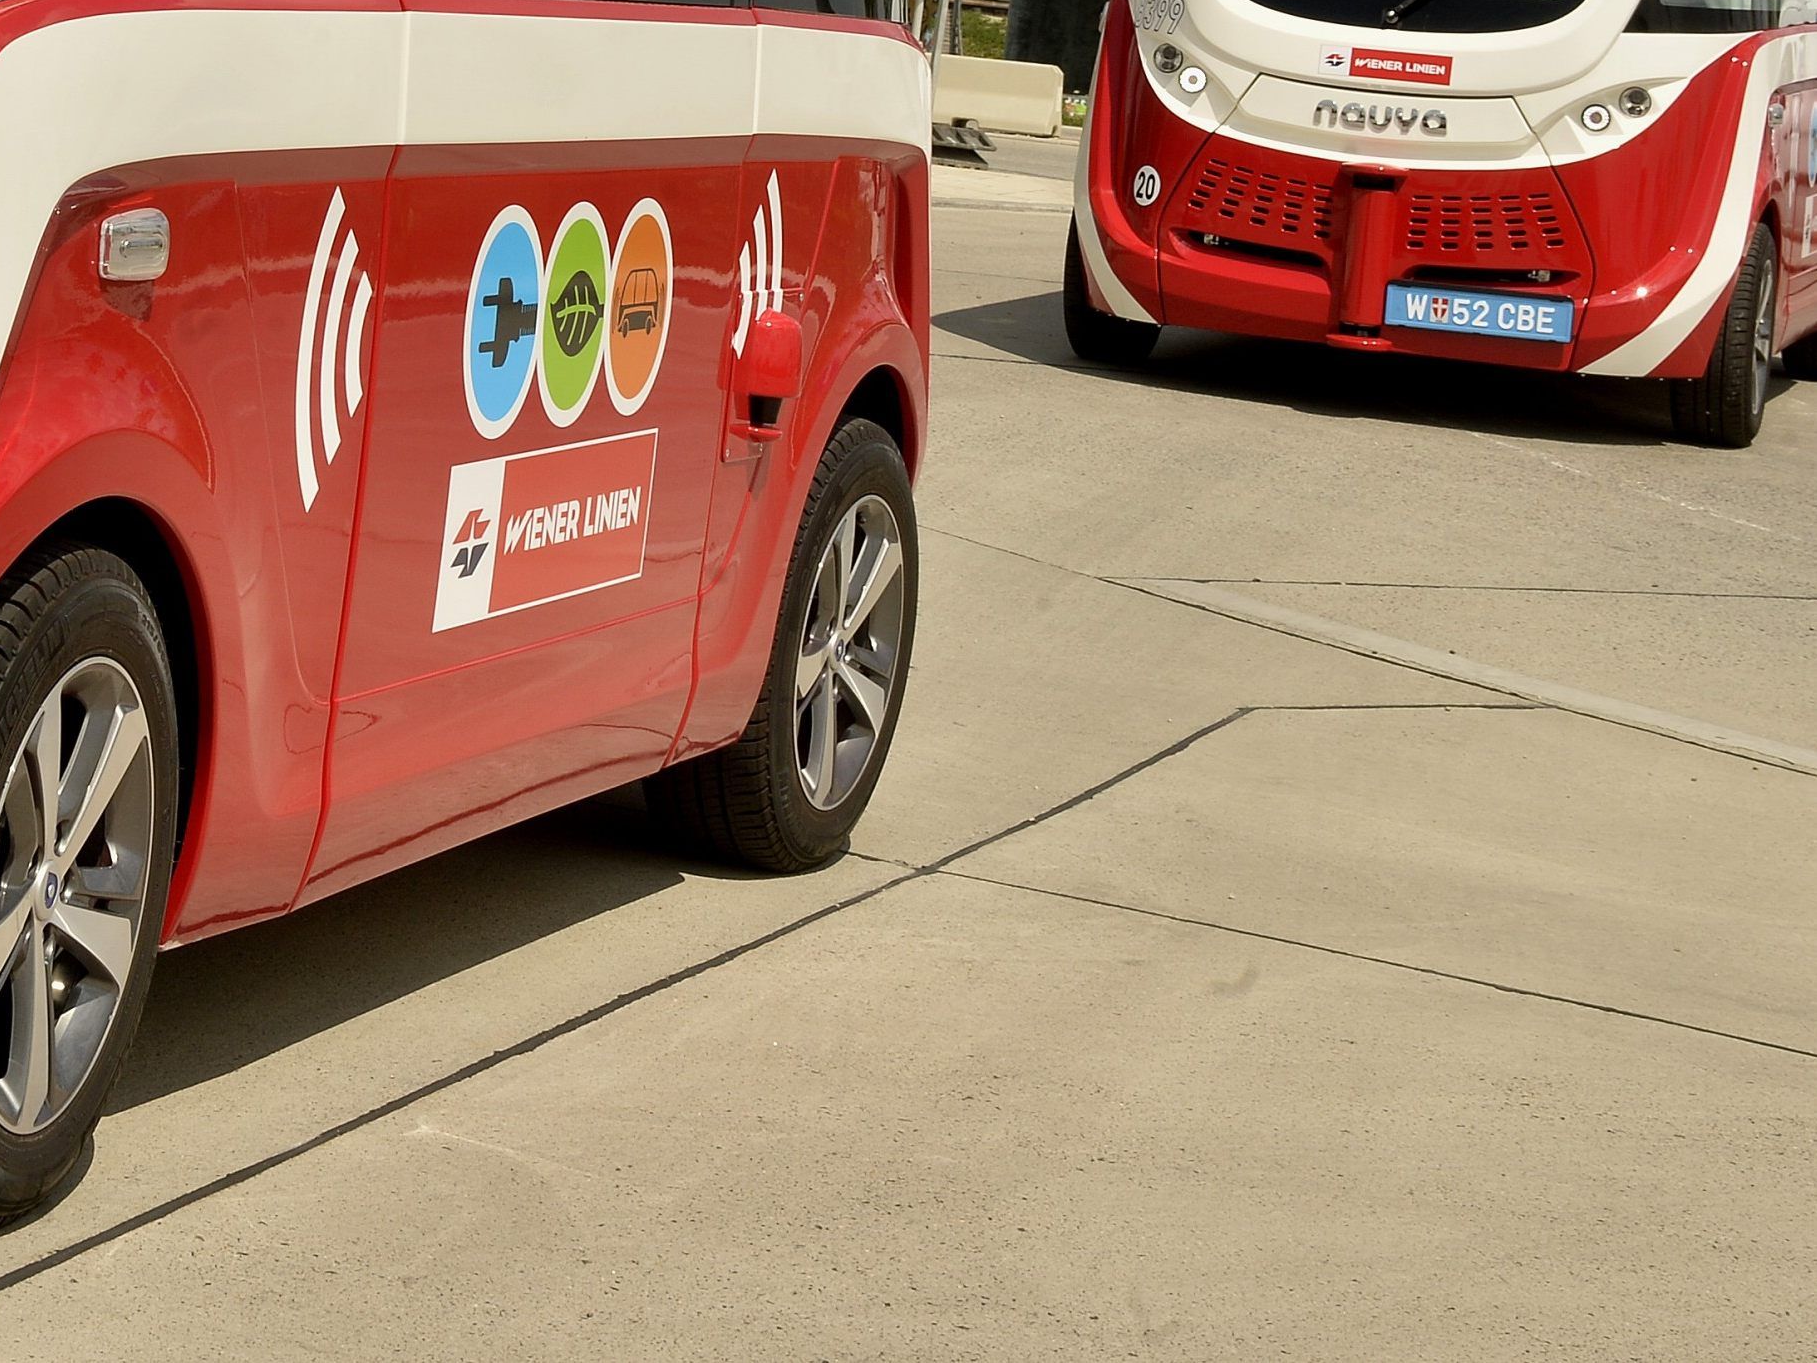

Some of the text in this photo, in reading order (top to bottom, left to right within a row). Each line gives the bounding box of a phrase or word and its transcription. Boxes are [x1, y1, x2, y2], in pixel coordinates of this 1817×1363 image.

[1354, 58, 1446, 75] WIENER LINIEN
[1136, 171, 1155, 199] 20
[1406, 293, 1556, 334] W 52 CBE
[504, 486, 641, 555] WIENER LINIEN
